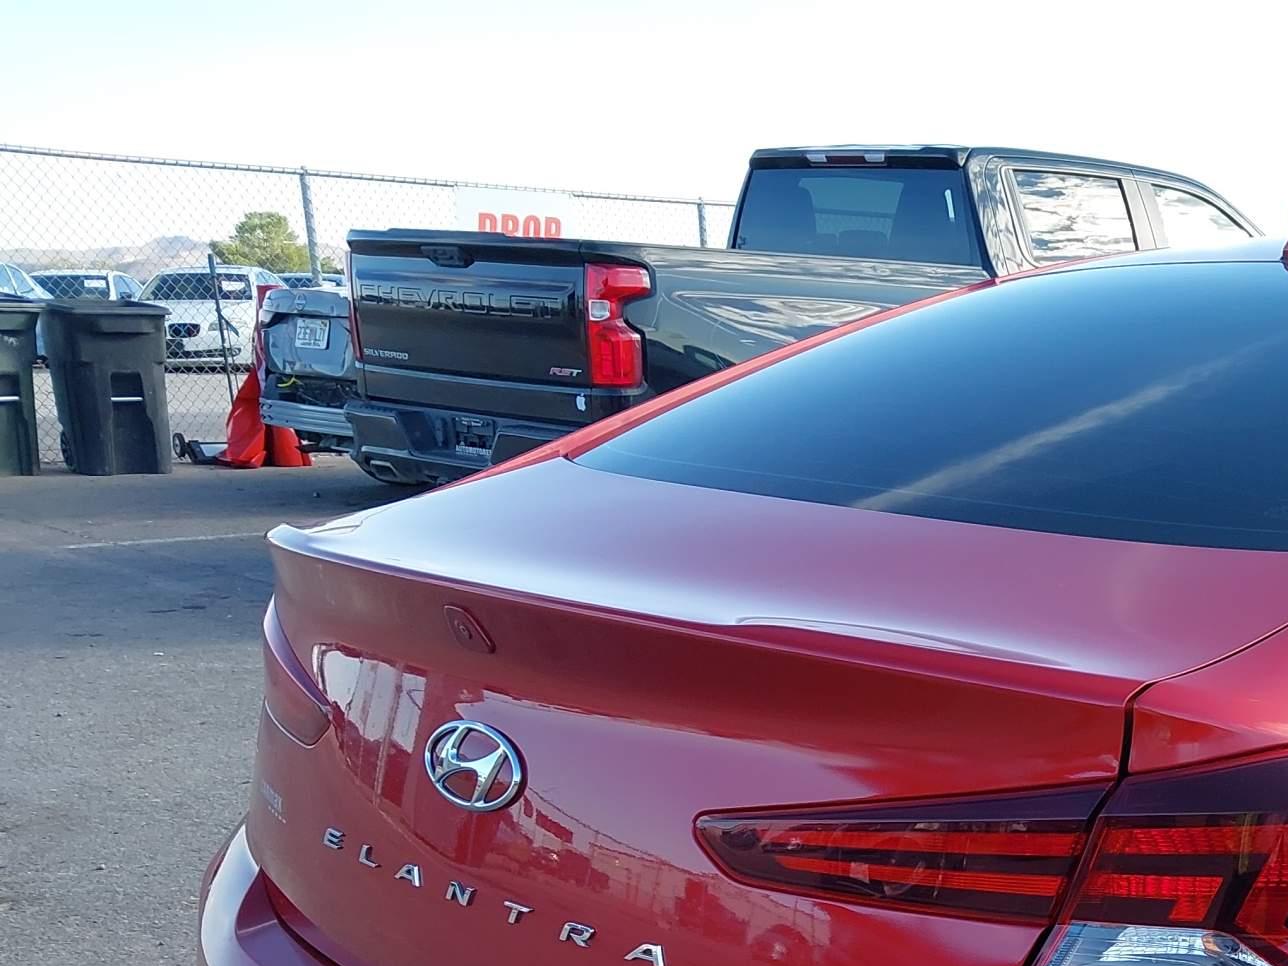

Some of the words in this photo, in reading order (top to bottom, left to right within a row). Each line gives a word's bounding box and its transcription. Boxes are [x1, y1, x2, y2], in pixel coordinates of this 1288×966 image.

[360, 284, 559, 319] CHEVROLET
[363, 348, 409, 361] SILVERADO
[549, 367, 583, 377] RST
